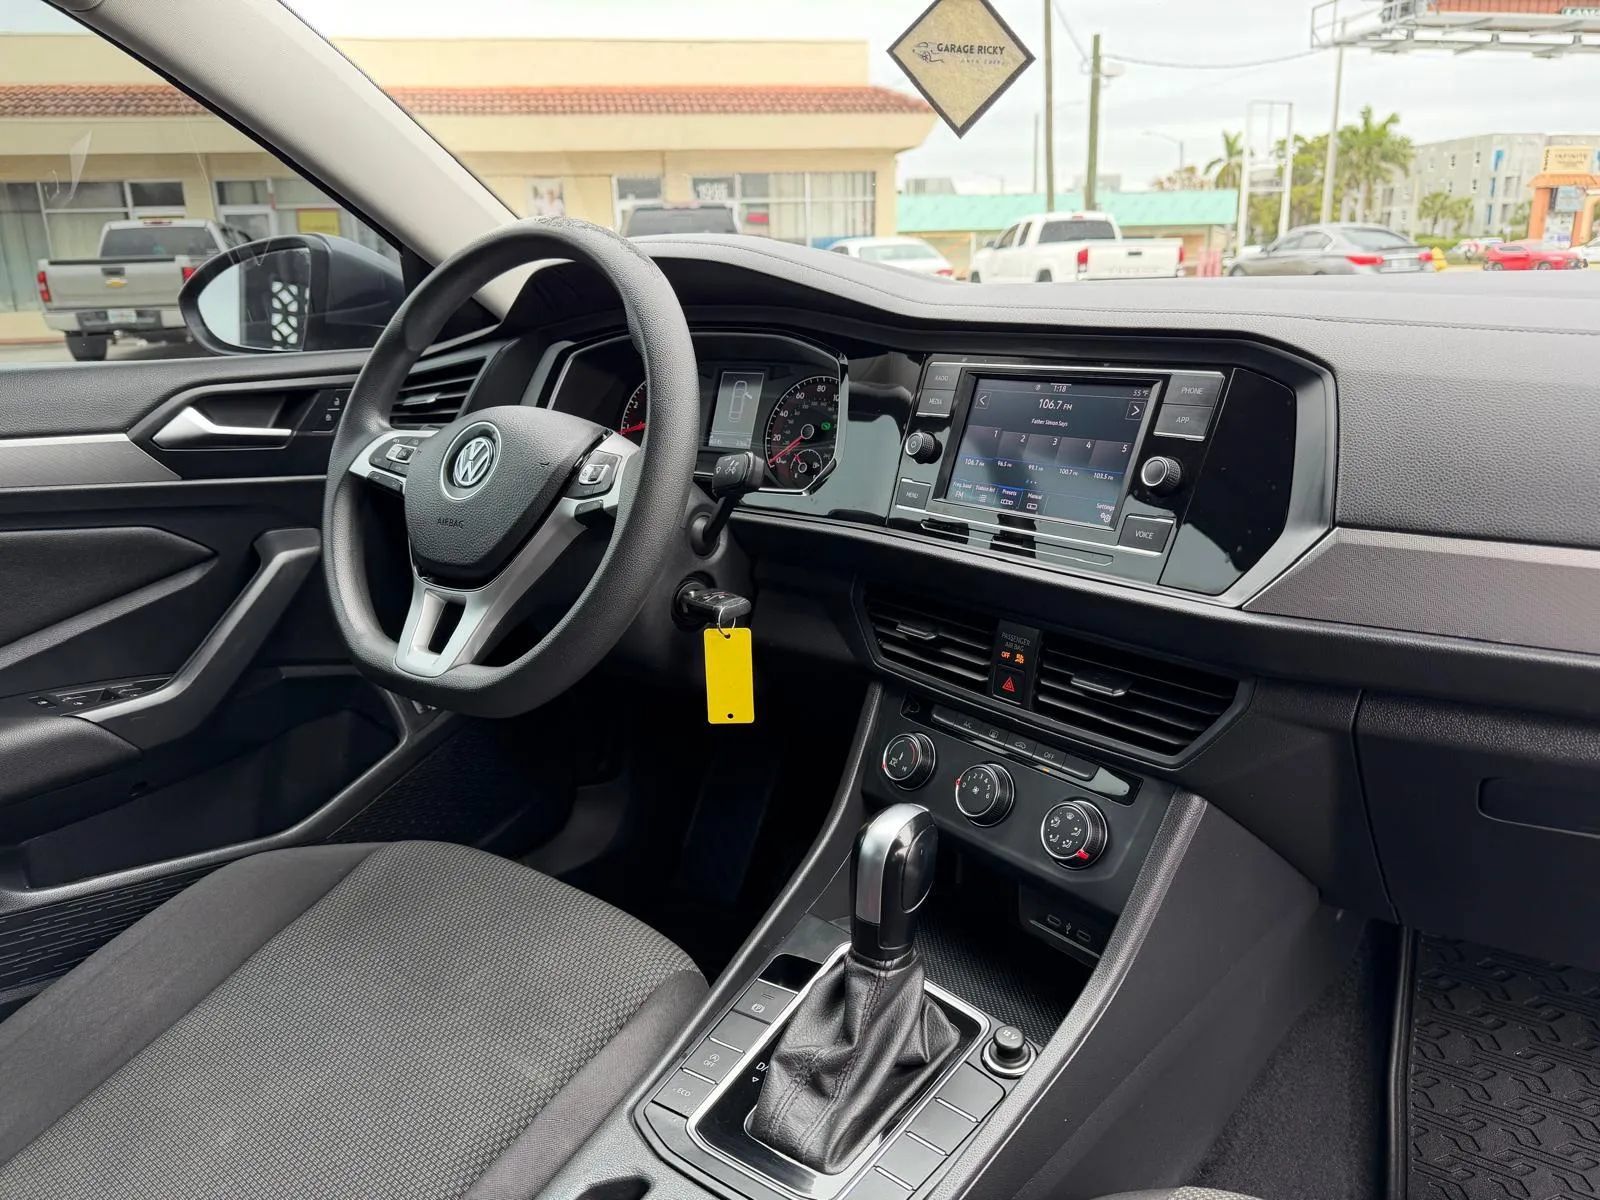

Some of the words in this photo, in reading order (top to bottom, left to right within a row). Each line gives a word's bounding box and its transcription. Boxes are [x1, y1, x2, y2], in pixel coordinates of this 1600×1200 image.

[937, 43, 974, 54] GARAGE
[977, 45, 1005, 55] RICKY
[1053, 385, 1066, 393] 1:18
[1181, 387, 1204, 395] PHONE
[1039, 398, 1062, 410] 106.7
[1176, 416, 1190, 424] APP
[1020, 435, 1026, 443] 2
[1052, 438, 1058, 446] 3
[1086, 441, 1091, 449] 4
[1121, 445, 1127, 453] 5
[437, 517, 464, 529] AIRBAG
[1135, 530, 1154, 539] VOICE
[1001, 632, 1031, 647] PASSENGER
[1001, 651, 1010, 659] OFF
[1043, 751, 1055, 760] OFF
[676, 1087, 691, 1097] ECO
